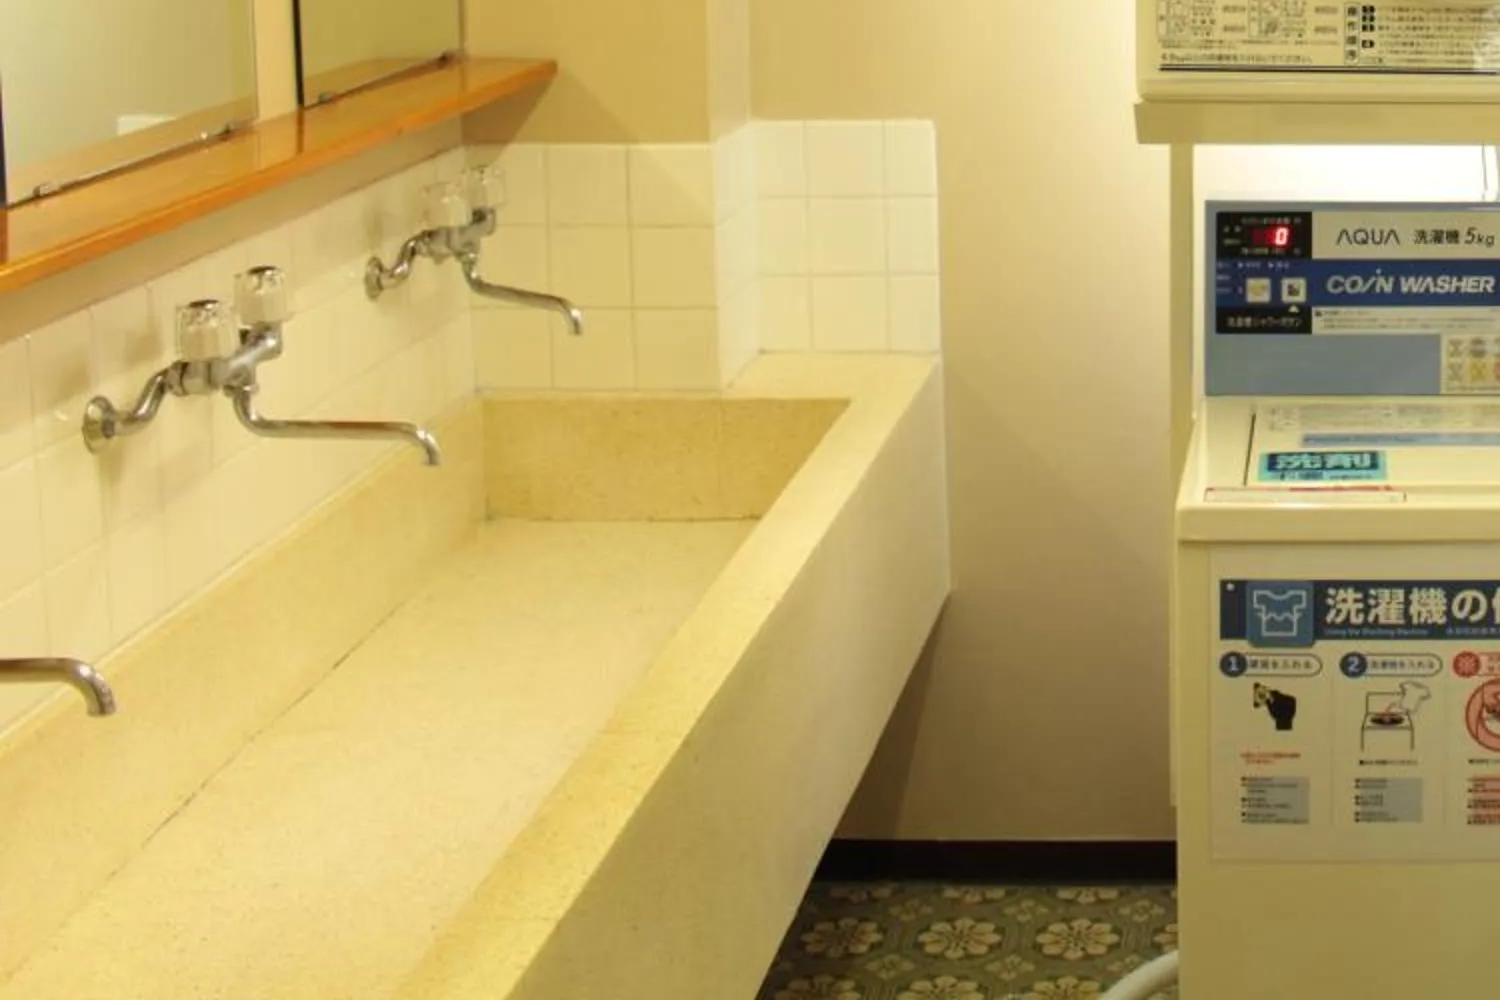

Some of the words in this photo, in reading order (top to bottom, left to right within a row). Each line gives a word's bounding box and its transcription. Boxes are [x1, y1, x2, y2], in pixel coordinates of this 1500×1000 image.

[1274, 226, 1289, 246] 0
[1335, 228, 1401, 246] AQUA
[1413, 228, 1460, 246] 洗濯機
[1464, 227, 1496, 247] 5kg
[1326, 268, 1394, 294] COIN
[1400, 275, 1496, 294] WASHER
[1347, 657, 1360, 671] 2
